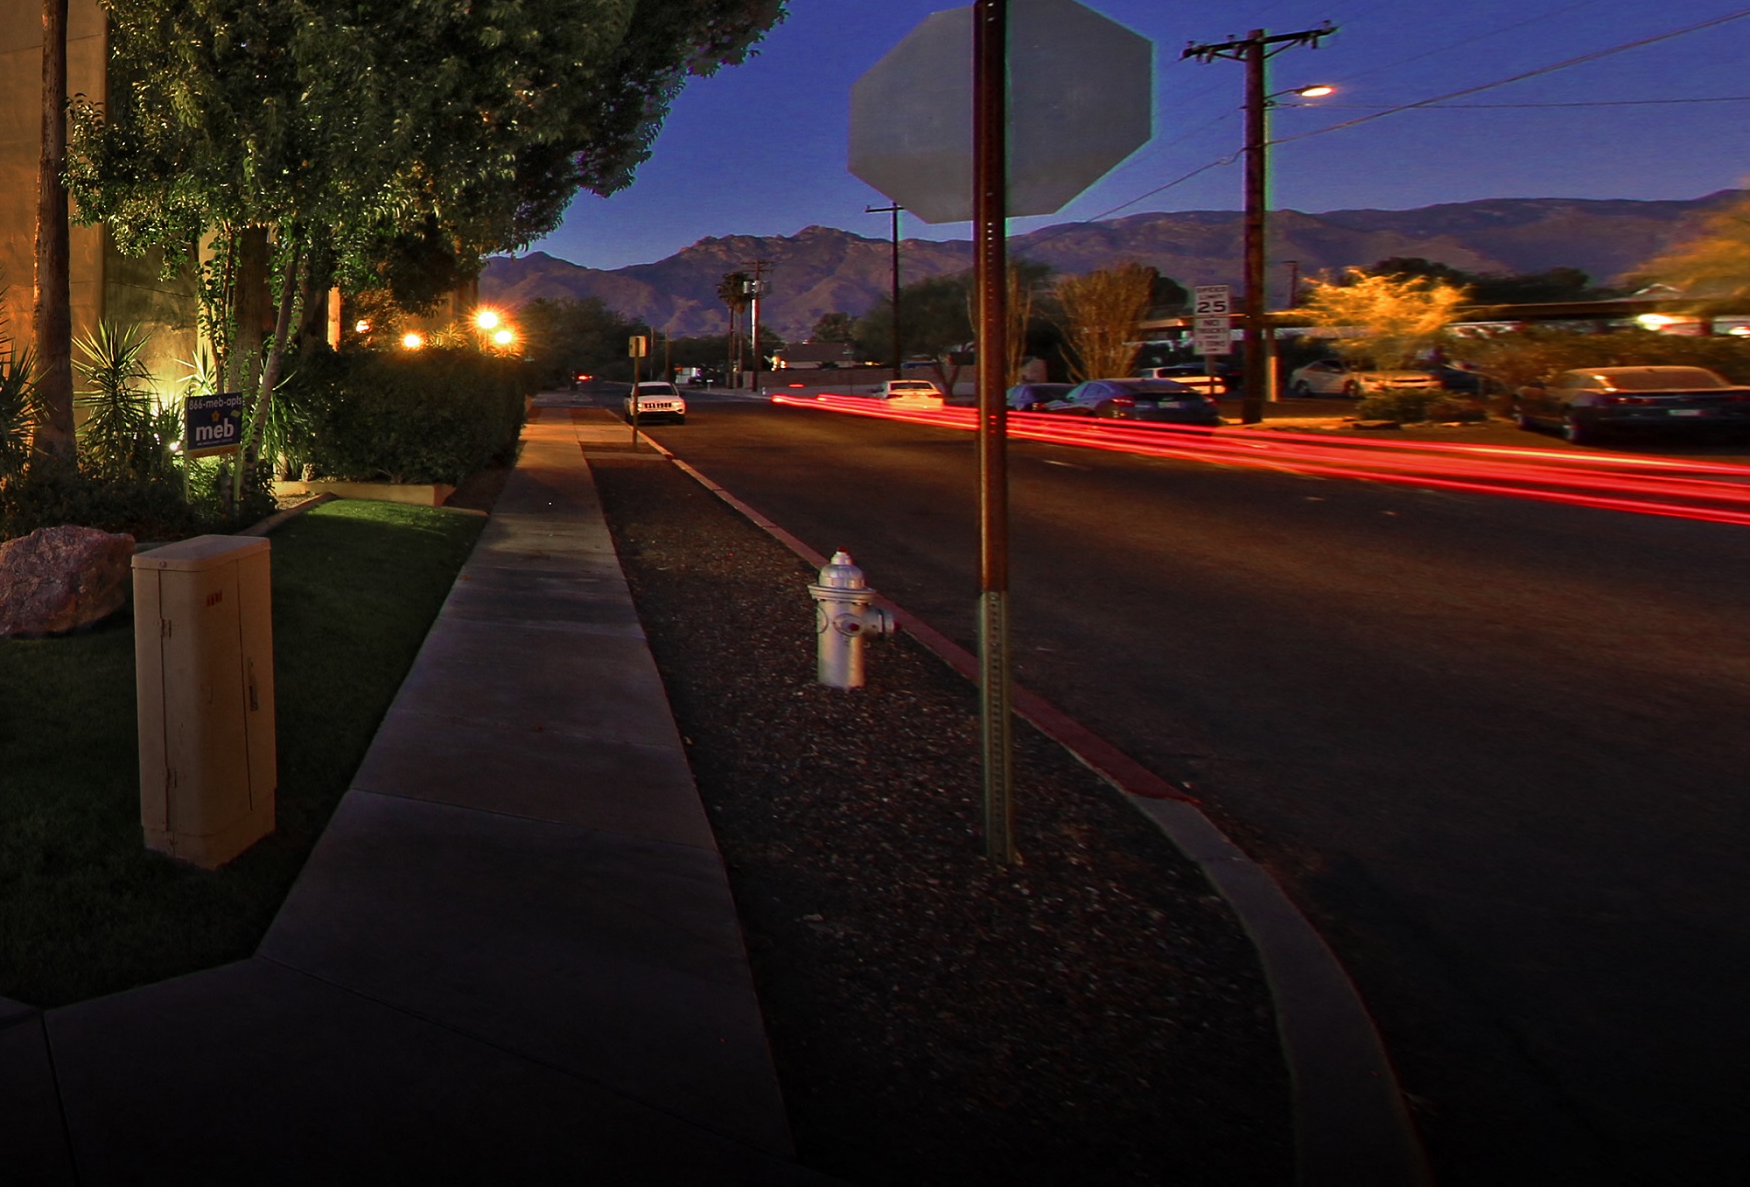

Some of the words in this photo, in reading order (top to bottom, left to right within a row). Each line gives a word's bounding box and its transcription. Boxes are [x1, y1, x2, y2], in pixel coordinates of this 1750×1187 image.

[1197, 300, 1226, 313] 25
[188, 396, 242, 410] 866-meb-apts
[196, 417, 234, 441] meb
